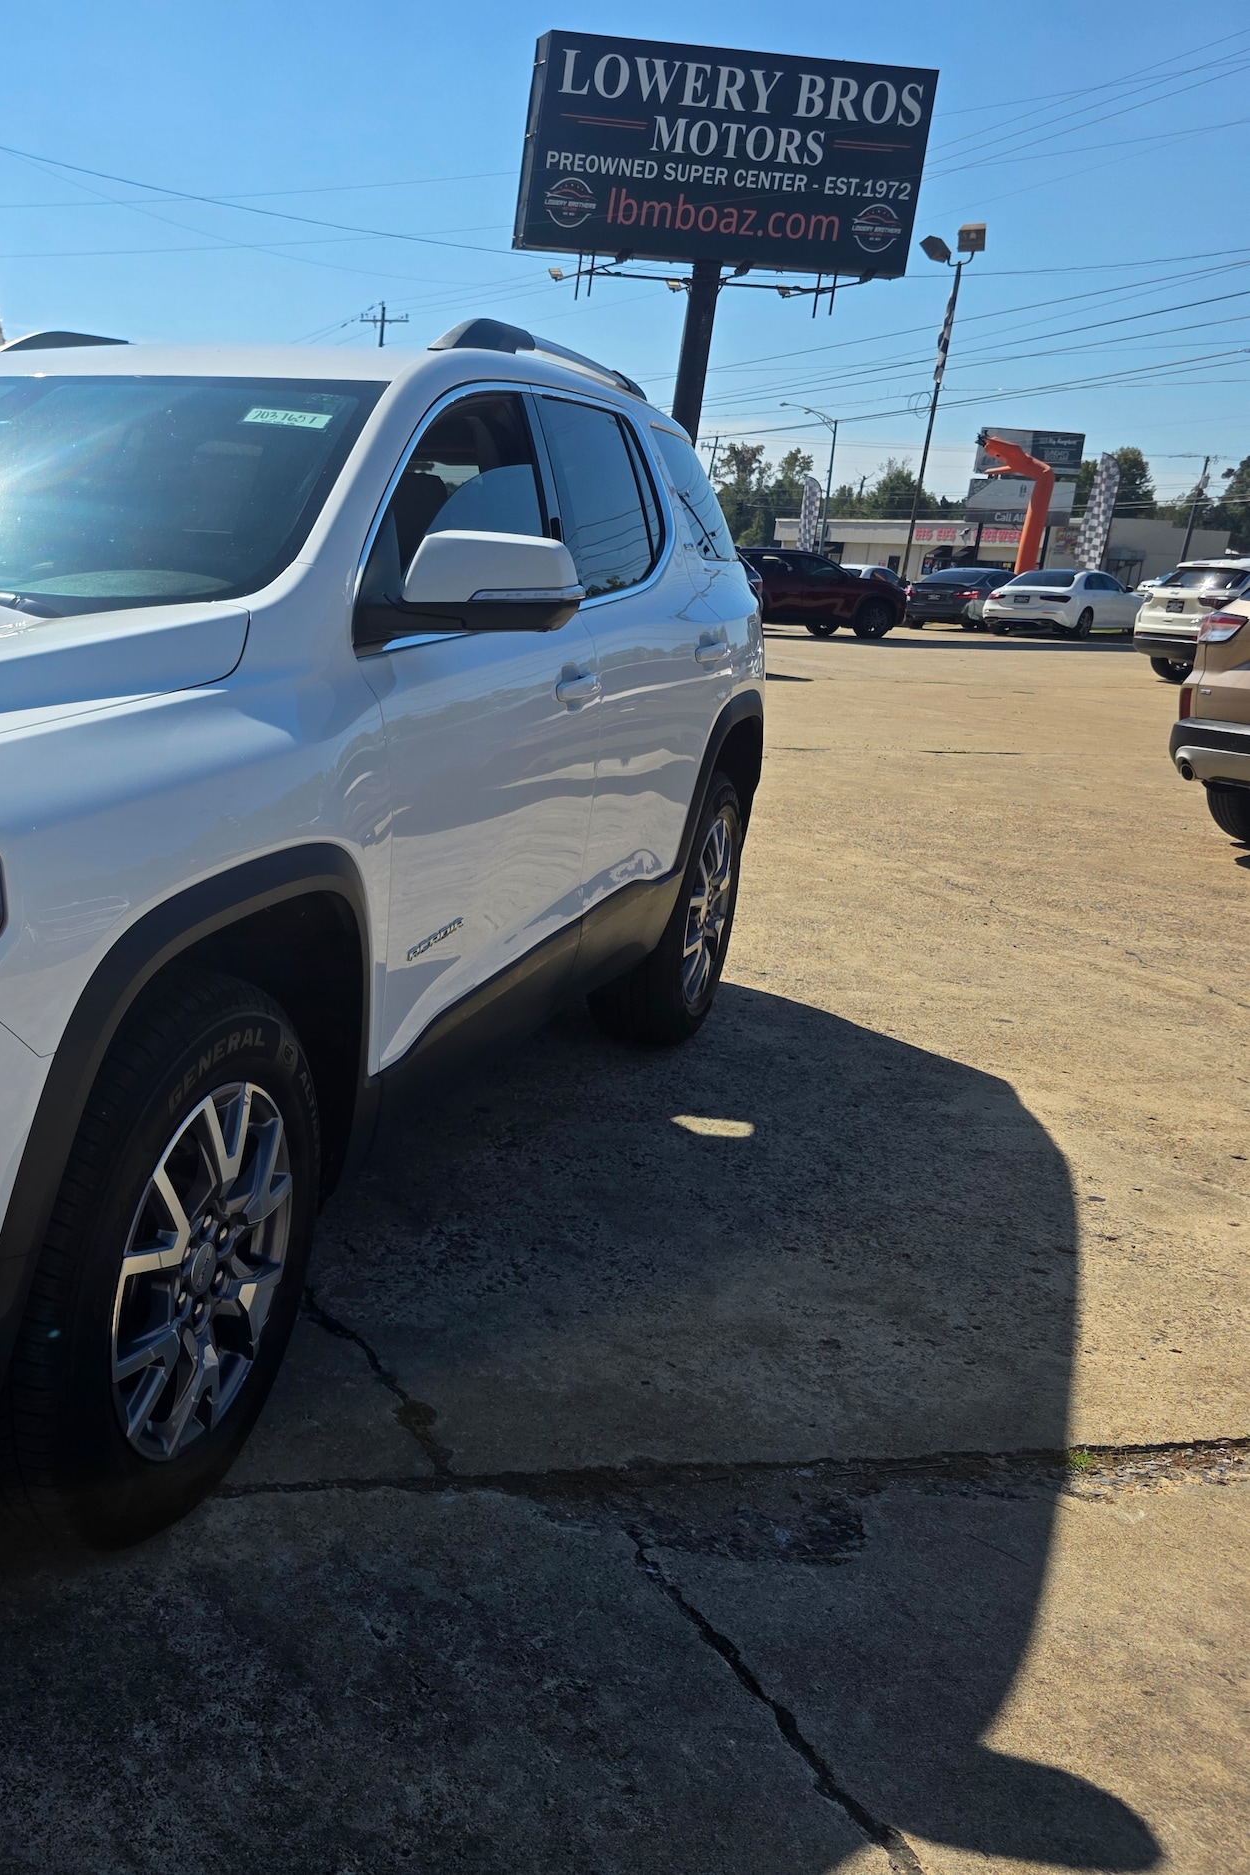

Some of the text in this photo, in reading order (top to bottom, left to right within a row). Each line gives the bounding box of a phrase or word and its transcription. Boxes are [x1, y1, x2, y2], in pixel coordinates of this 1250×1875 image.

[558, 49, 925, 128] LOWERY BROS
[649, 115, 826, 166] MOTORS
[546, 151, 659, 179] PREOWNED
[663, 163, 728, 186] SUPER
[733, 170, 807, 192] CENTER
[824, 177, 911, 200] EST.1972
[607, 187, 840, 242] lbmboaz.com
[994, 512, 1012, 521] Call
[166, 1027, 266, 1114] GENERAL
